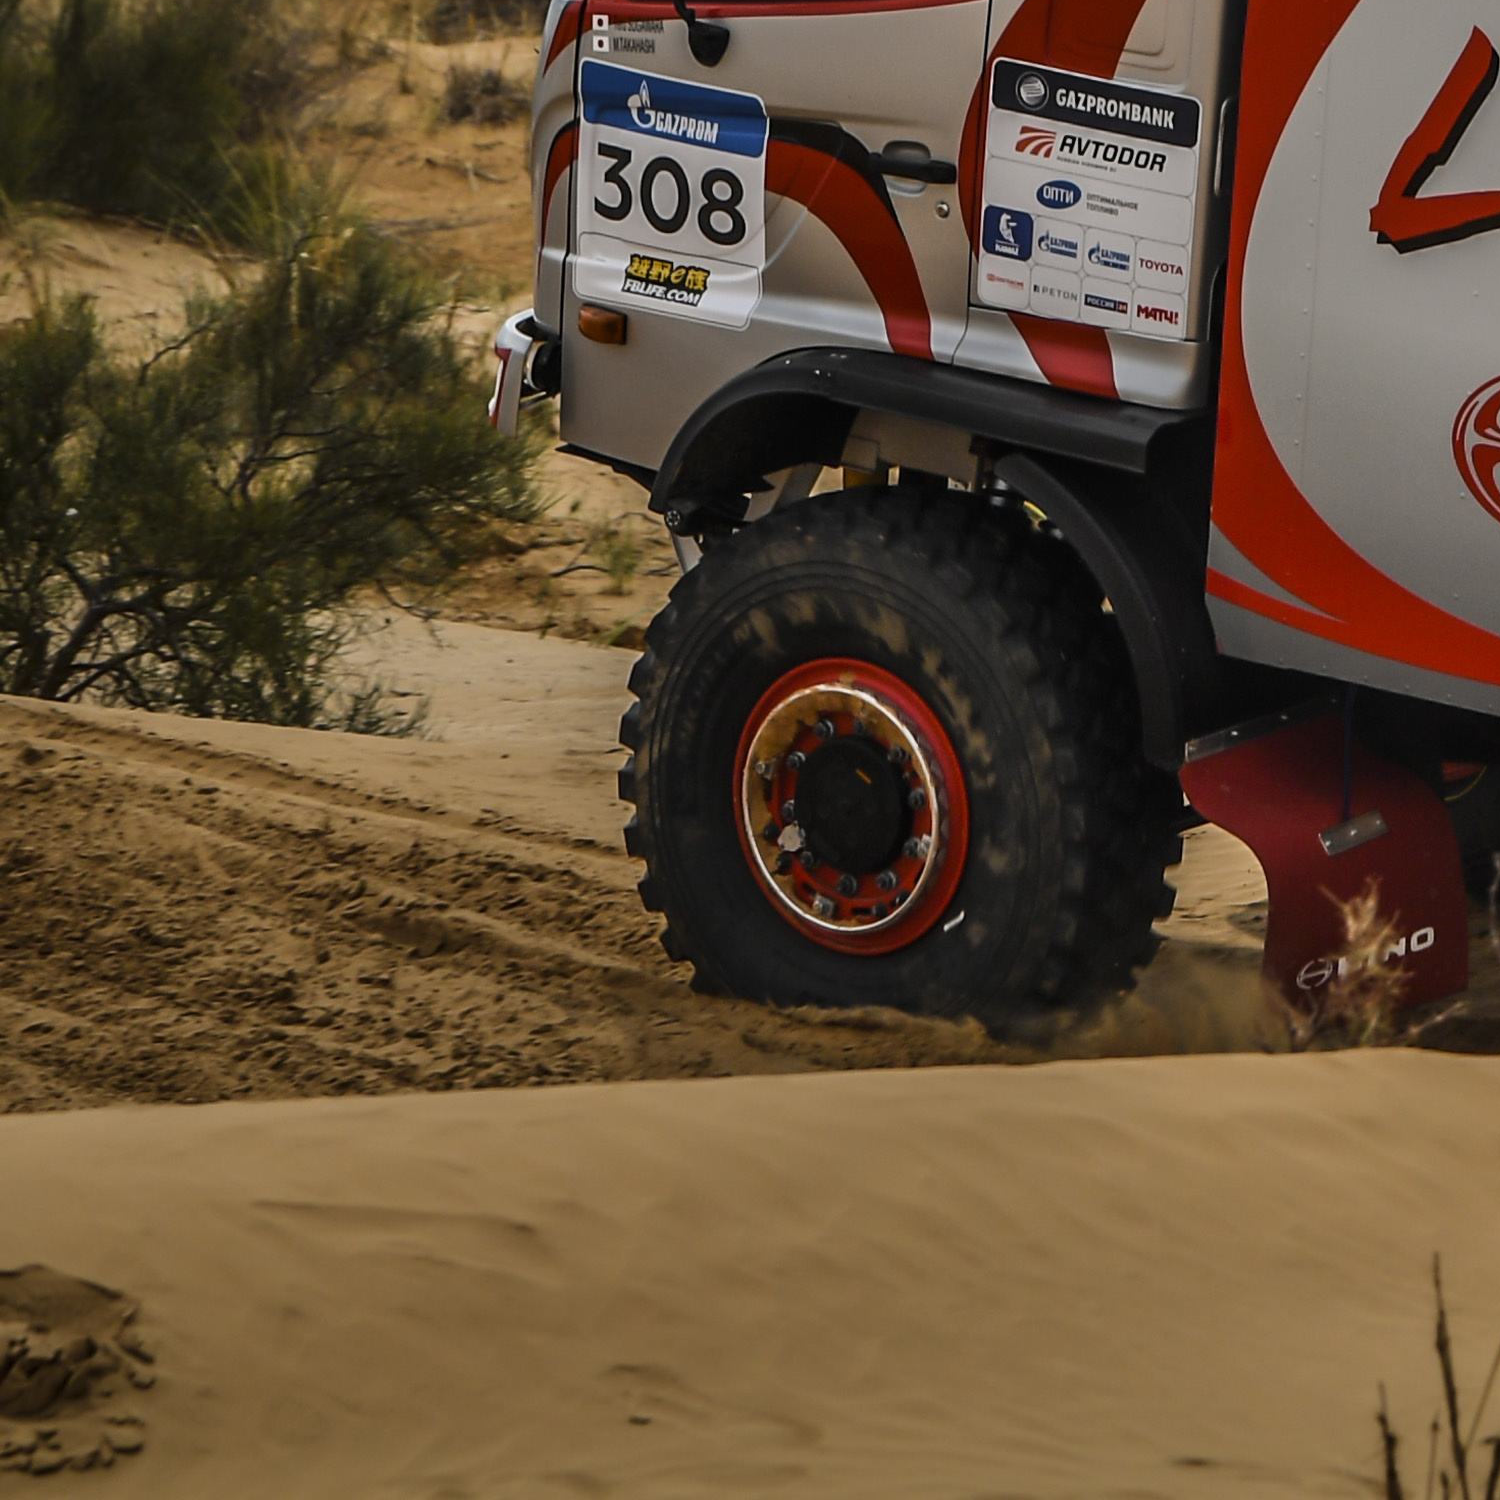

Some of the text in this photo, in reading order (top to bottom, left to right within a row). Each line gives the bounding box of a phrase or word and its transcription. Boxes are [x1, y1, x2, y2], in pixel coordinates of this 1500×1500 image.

[1055, 88, 1175, 130] GAZPROMBANK
[655, 111, 719, 144] GAZPROM
[1059, 134, 1167, 173] AVTODOR
[594, 142, 746, 246] 308
[1042, 185, 1074, 204] ОПТИ
[1138, 257, 1184, 277] TOYOTA
